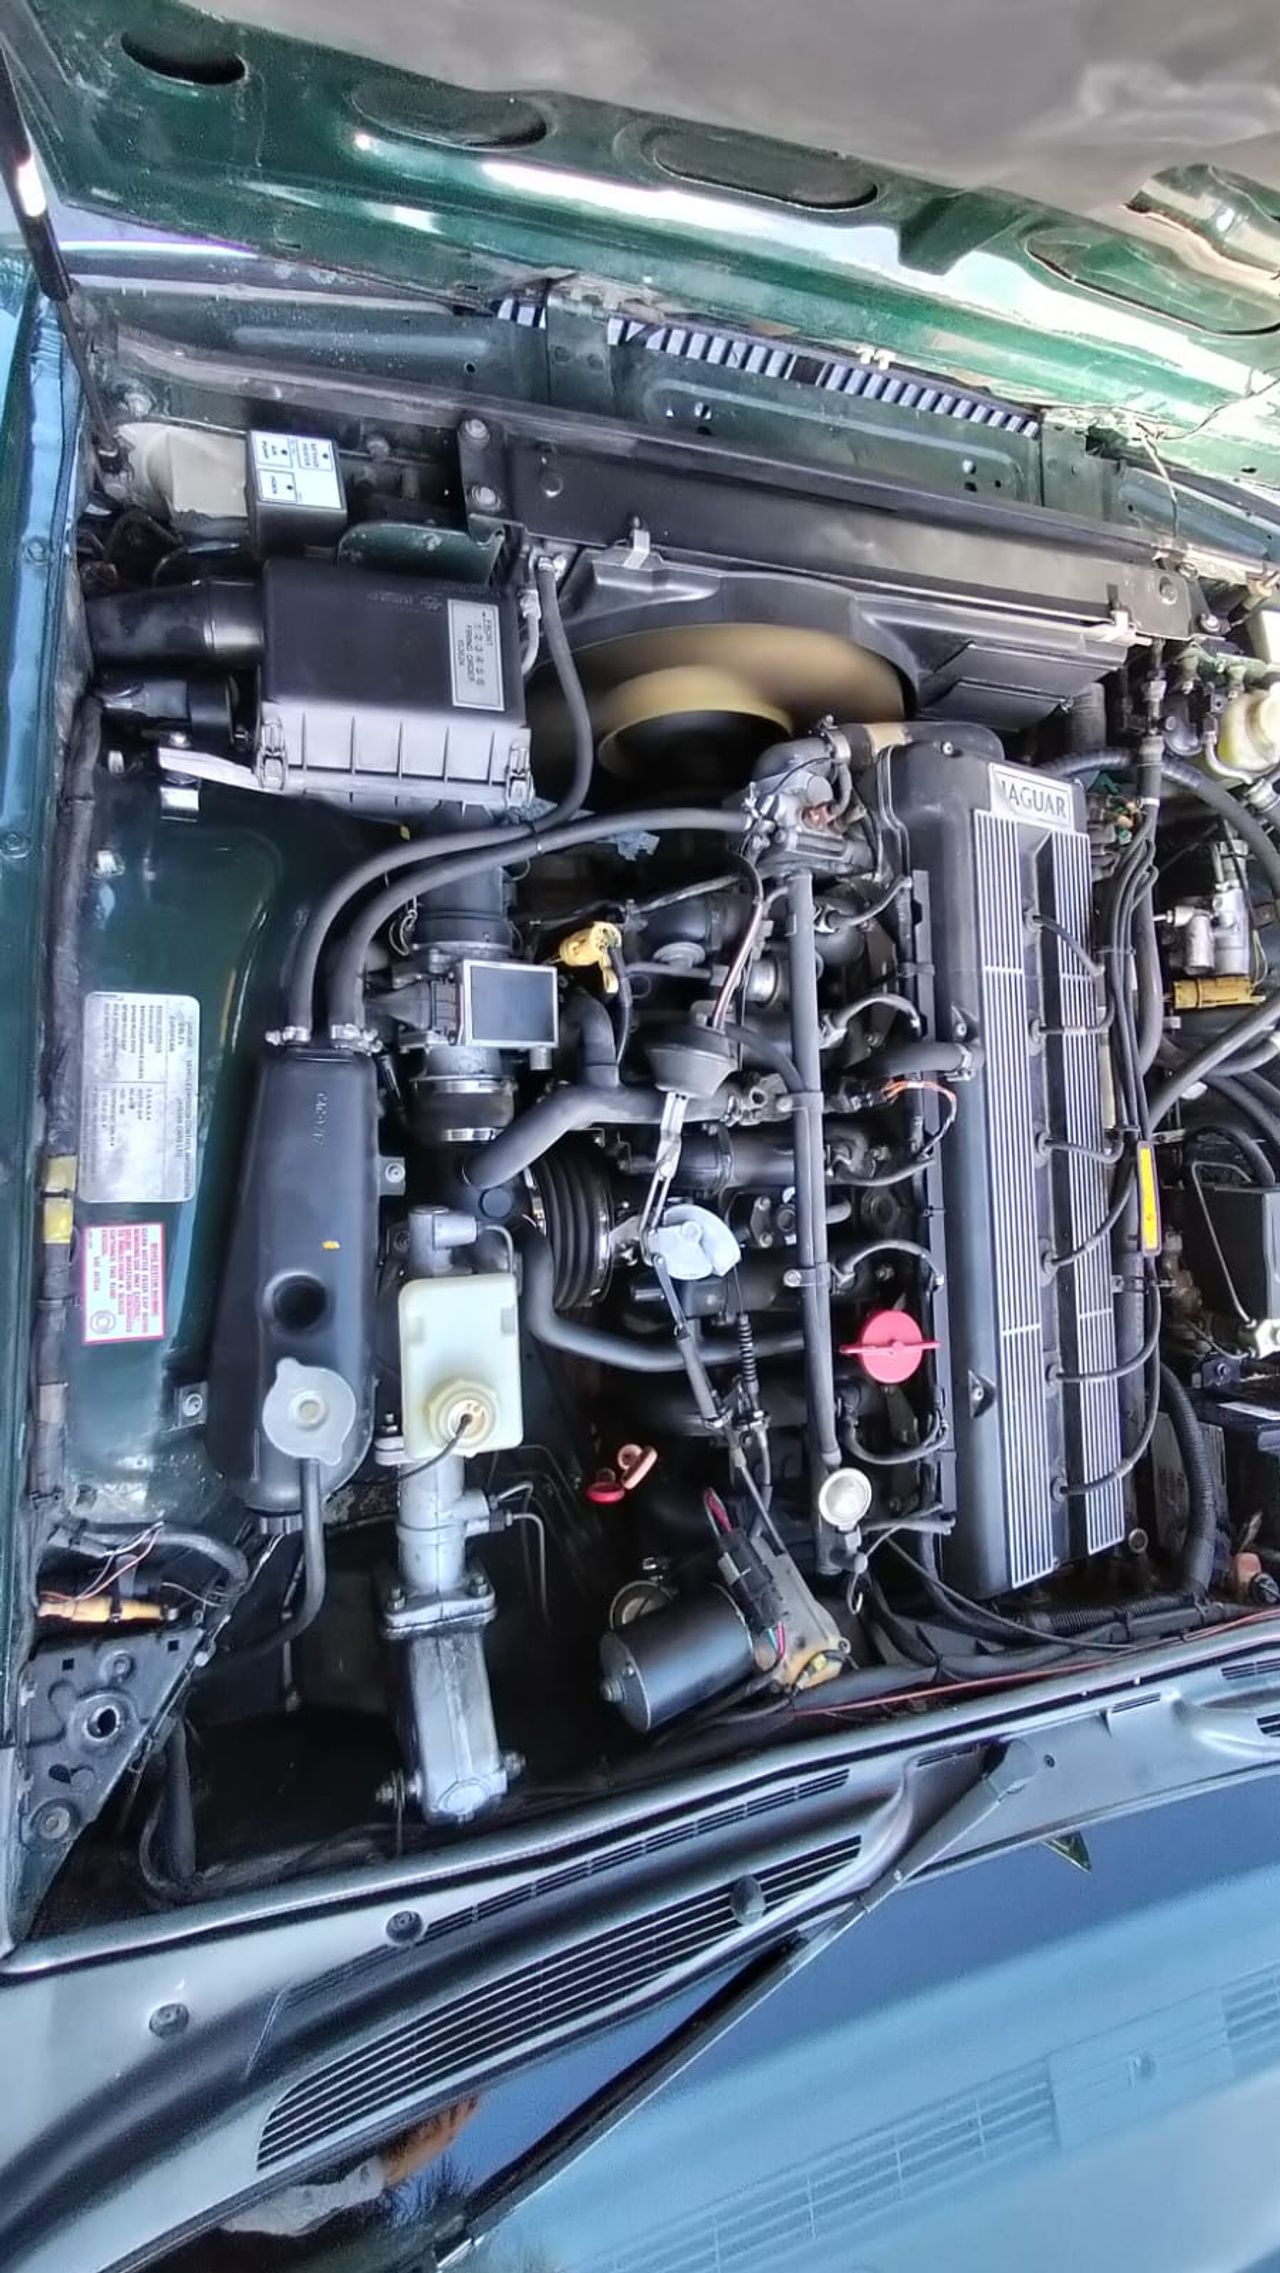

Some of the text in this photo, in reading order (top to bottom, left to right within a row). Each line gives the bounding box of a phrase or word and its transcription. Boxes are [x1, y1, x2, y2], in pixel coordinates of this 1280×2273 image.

[465, 625, 476, 682] FIRING ORDER
[484, 620, 493, 646] FRONT
